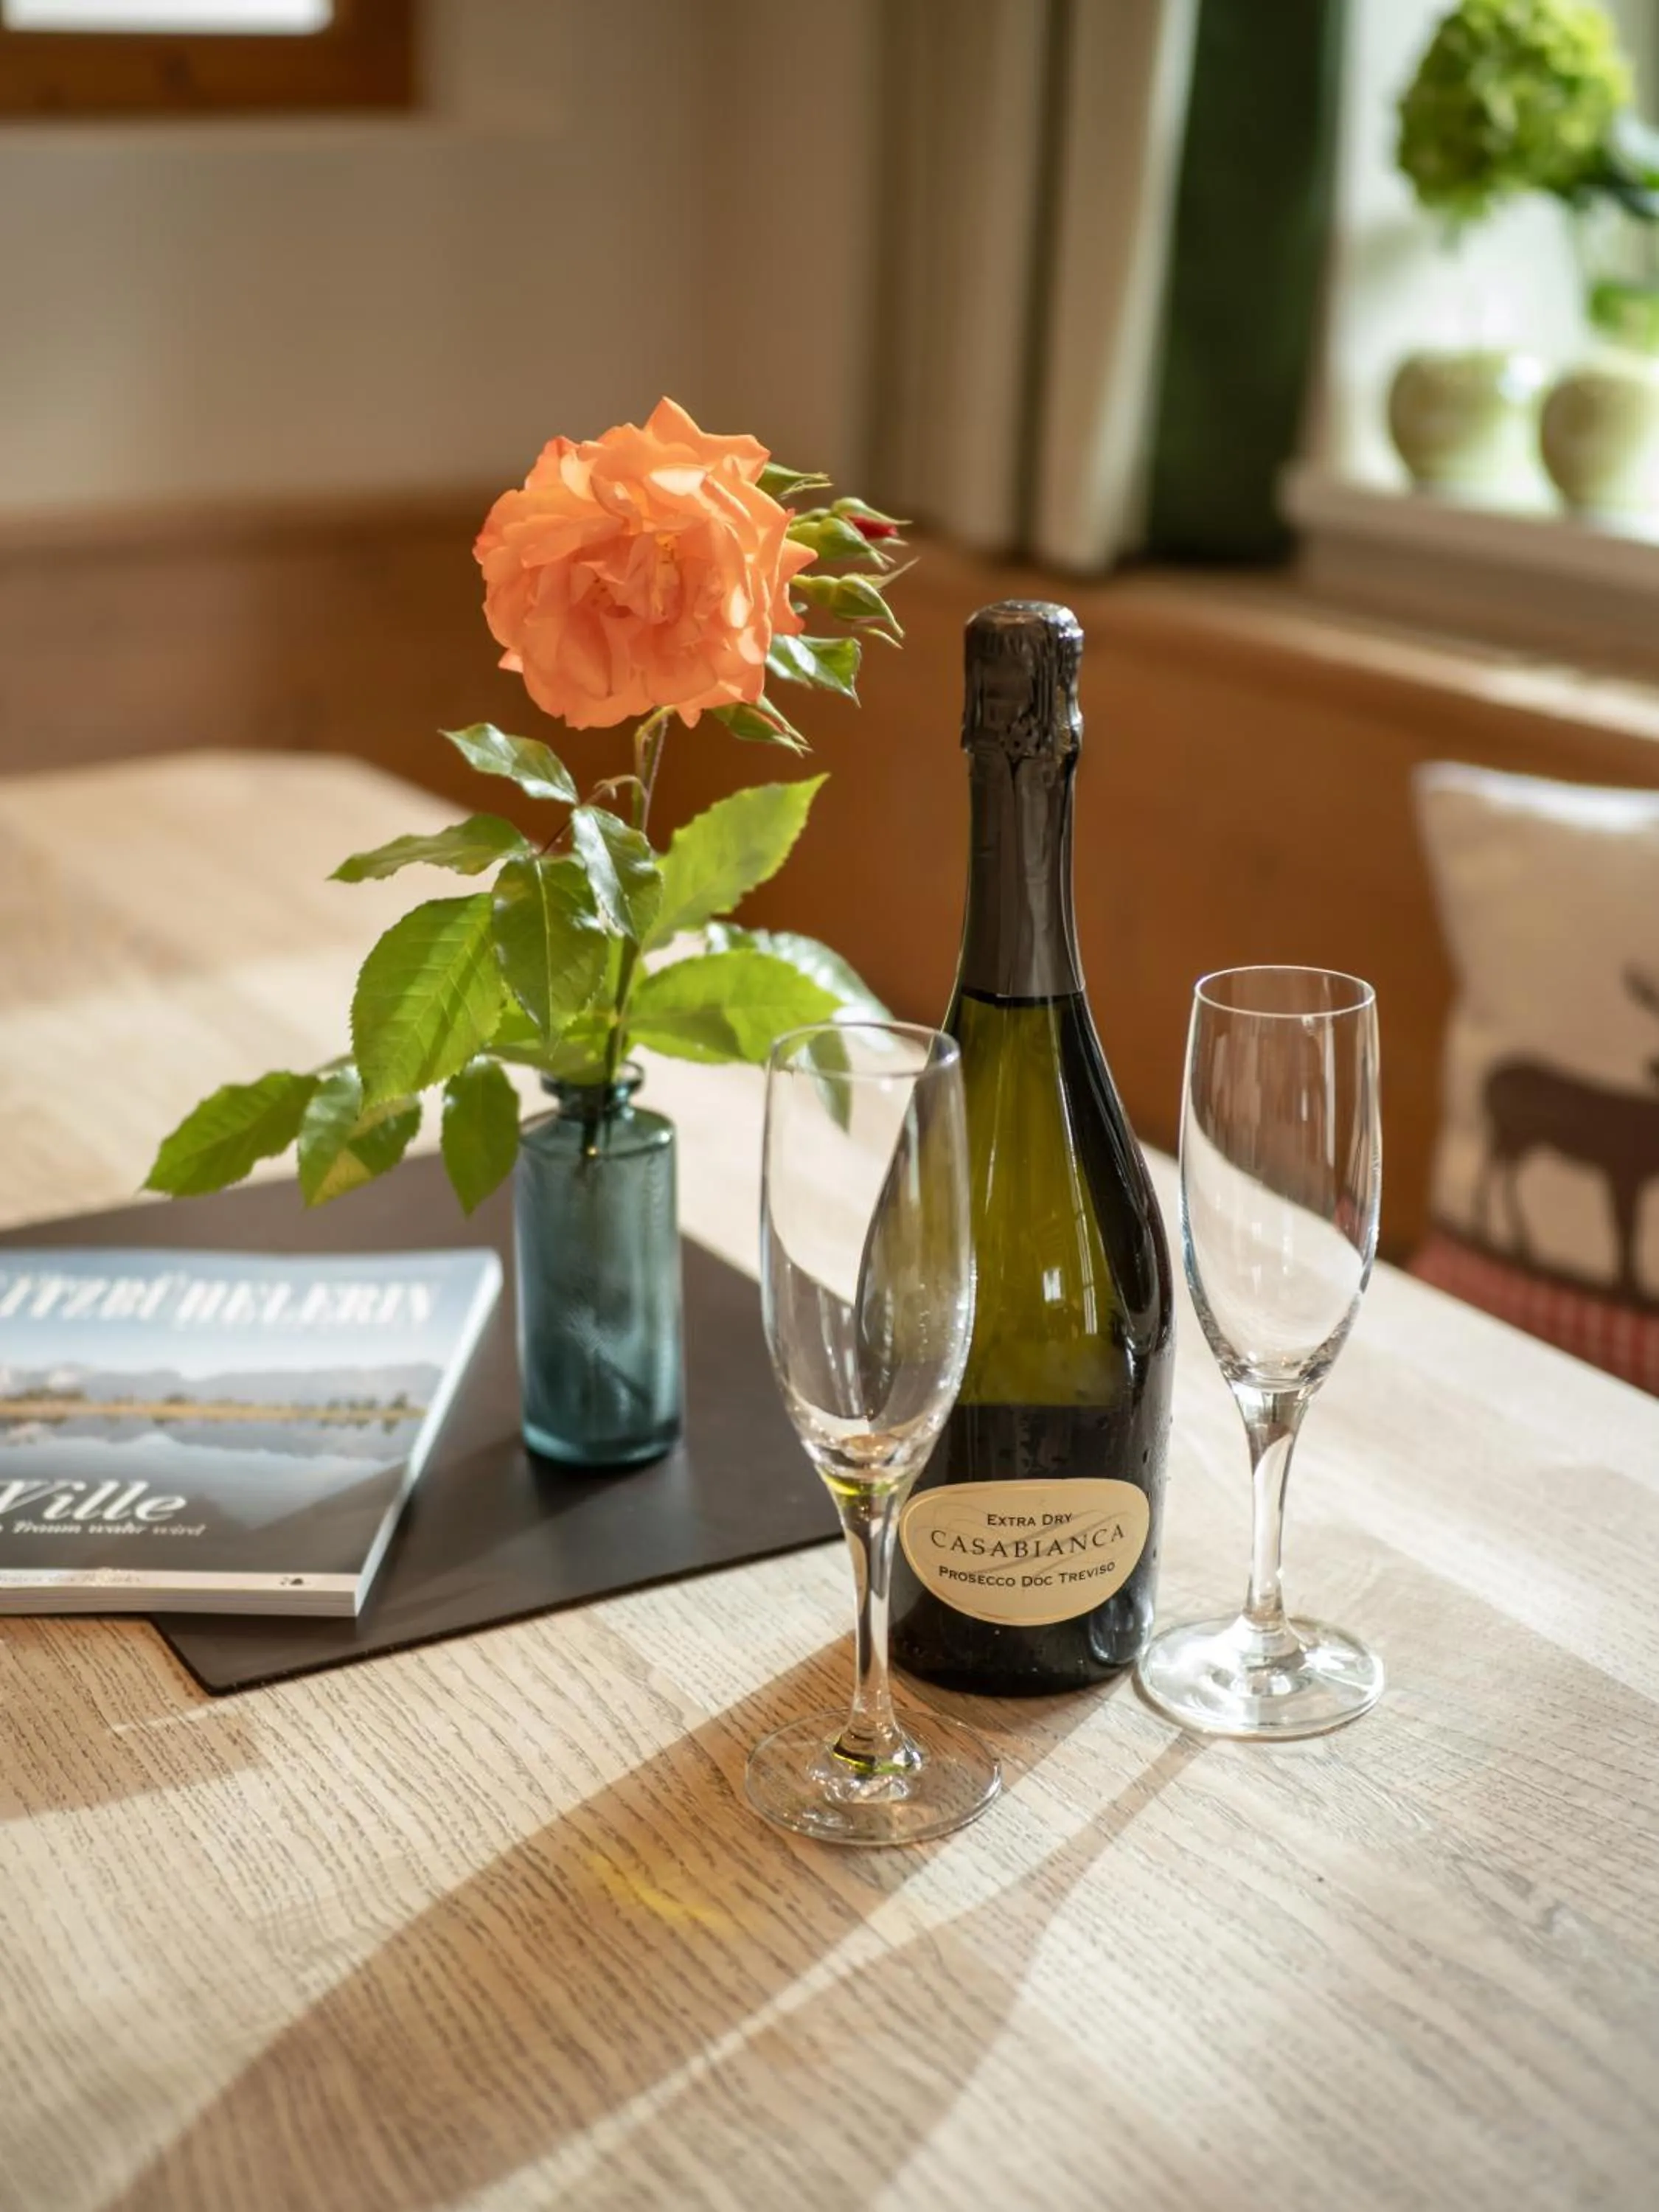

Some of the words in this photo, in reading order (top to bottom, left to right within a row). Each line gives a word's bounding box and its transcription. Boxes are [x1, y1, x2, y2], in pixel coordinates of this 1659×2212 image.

[0, 1270, 439, 1326] ITZBÜHELERIN
[0, 1478, 187, 1520] Ville
[931, 1523, 1125, 1559] CASABIANCA
